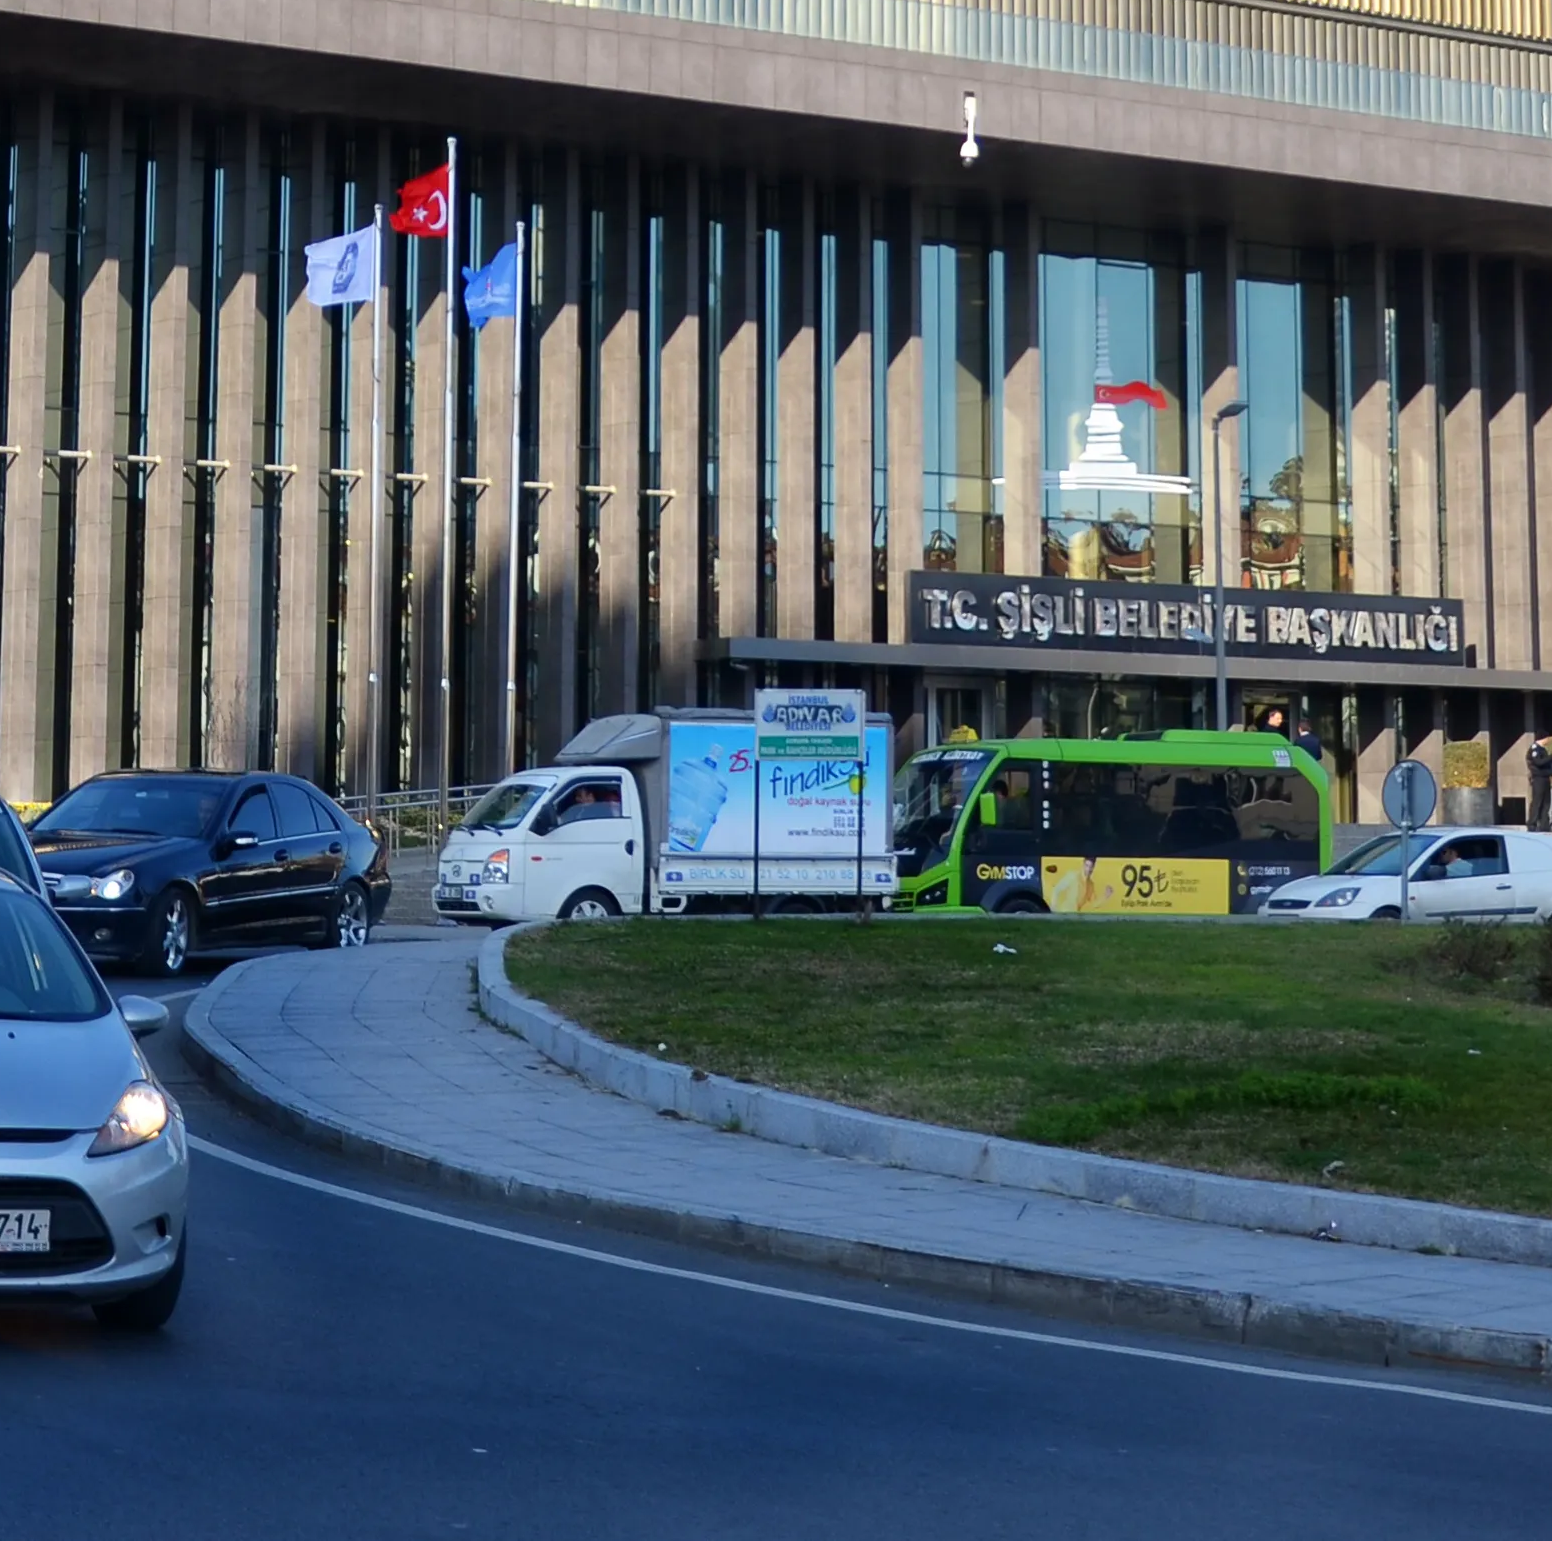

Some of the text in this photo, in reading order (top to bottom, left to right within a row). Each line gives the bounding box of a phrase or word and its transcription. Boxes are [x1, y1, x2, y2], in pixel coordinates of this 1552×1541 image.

[921, 585, 1458, 653] T.C. ŞİŞLİ BELEDİYE BAŞKANLIĞI
[976, 863, 1035, 880] GYMSTOP
